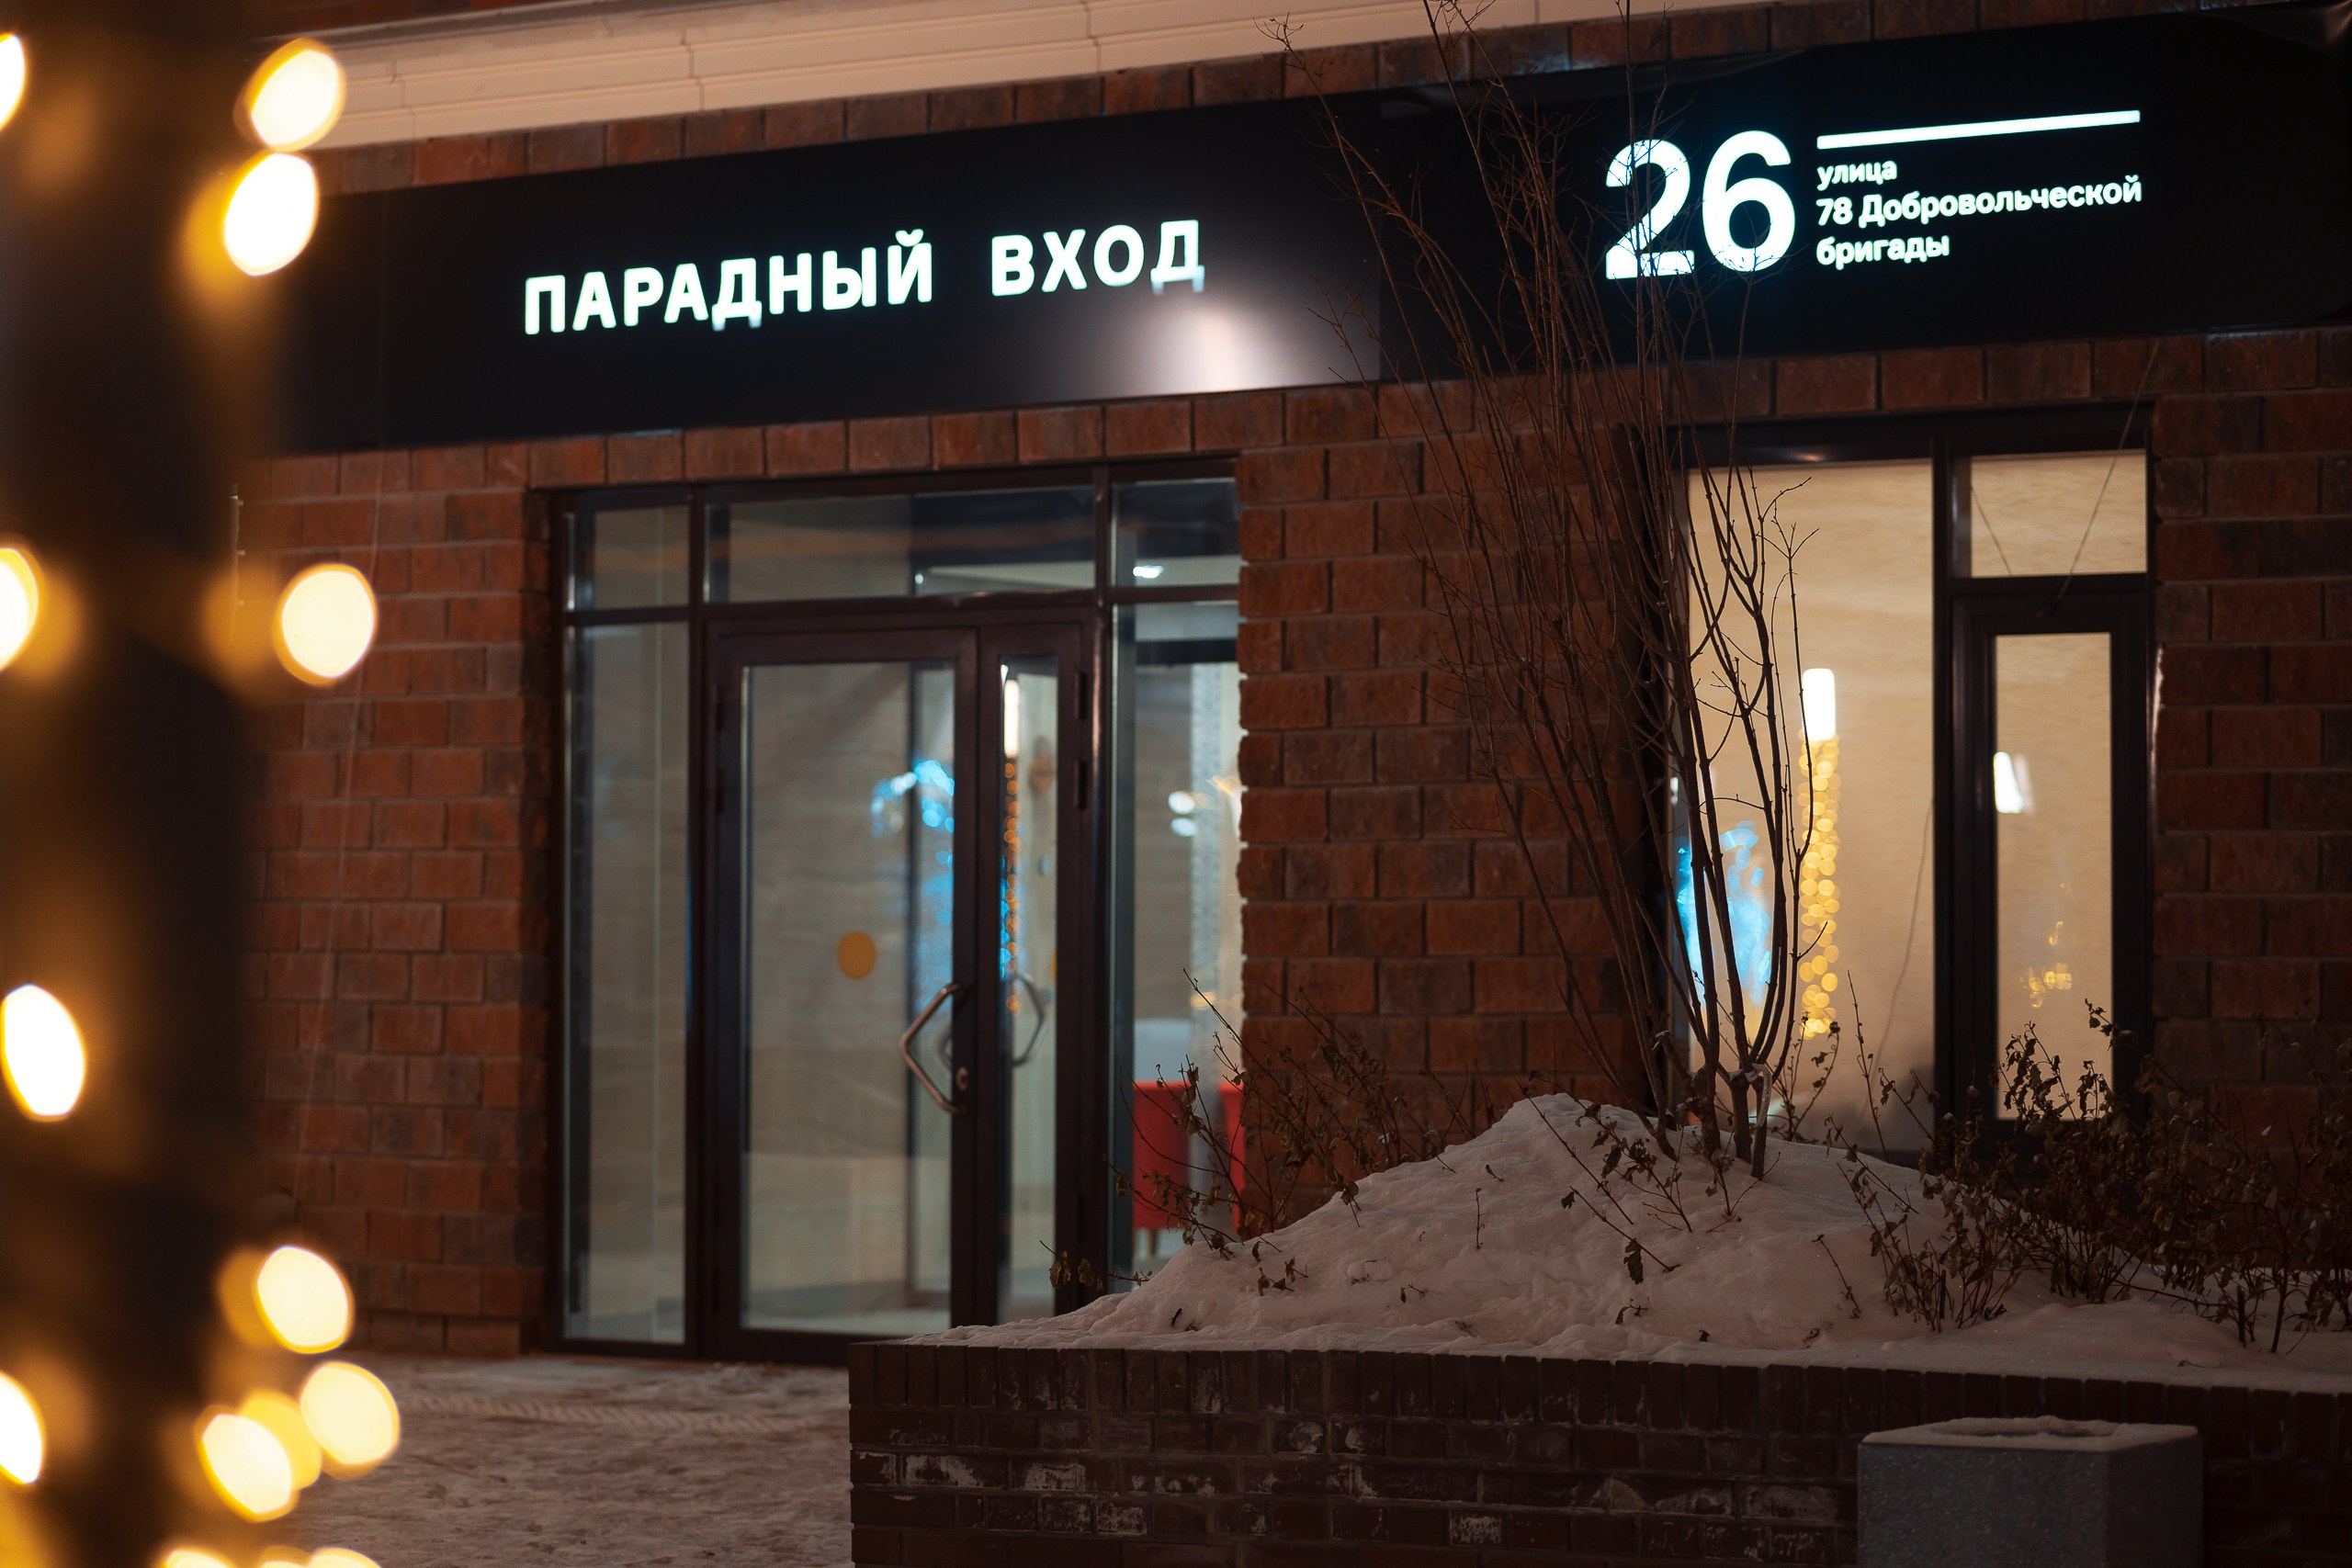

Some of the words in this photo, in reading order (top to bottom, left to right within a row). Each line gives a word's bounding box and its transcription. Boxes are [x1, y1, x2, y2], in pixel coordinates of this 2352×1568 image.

[1815, 196, 1853, 227] 78
[1858, 175, 2143, 230] Добровольческой
[1816, 160, 1898, 191] улица
[1605, 130, 1796, 280] 26
[525, 229, 933, 335] ПАРАДНЫЙ
[991, 220, 1205, 296] ВХОД
[1815, 234, 1951, 271] бригады
